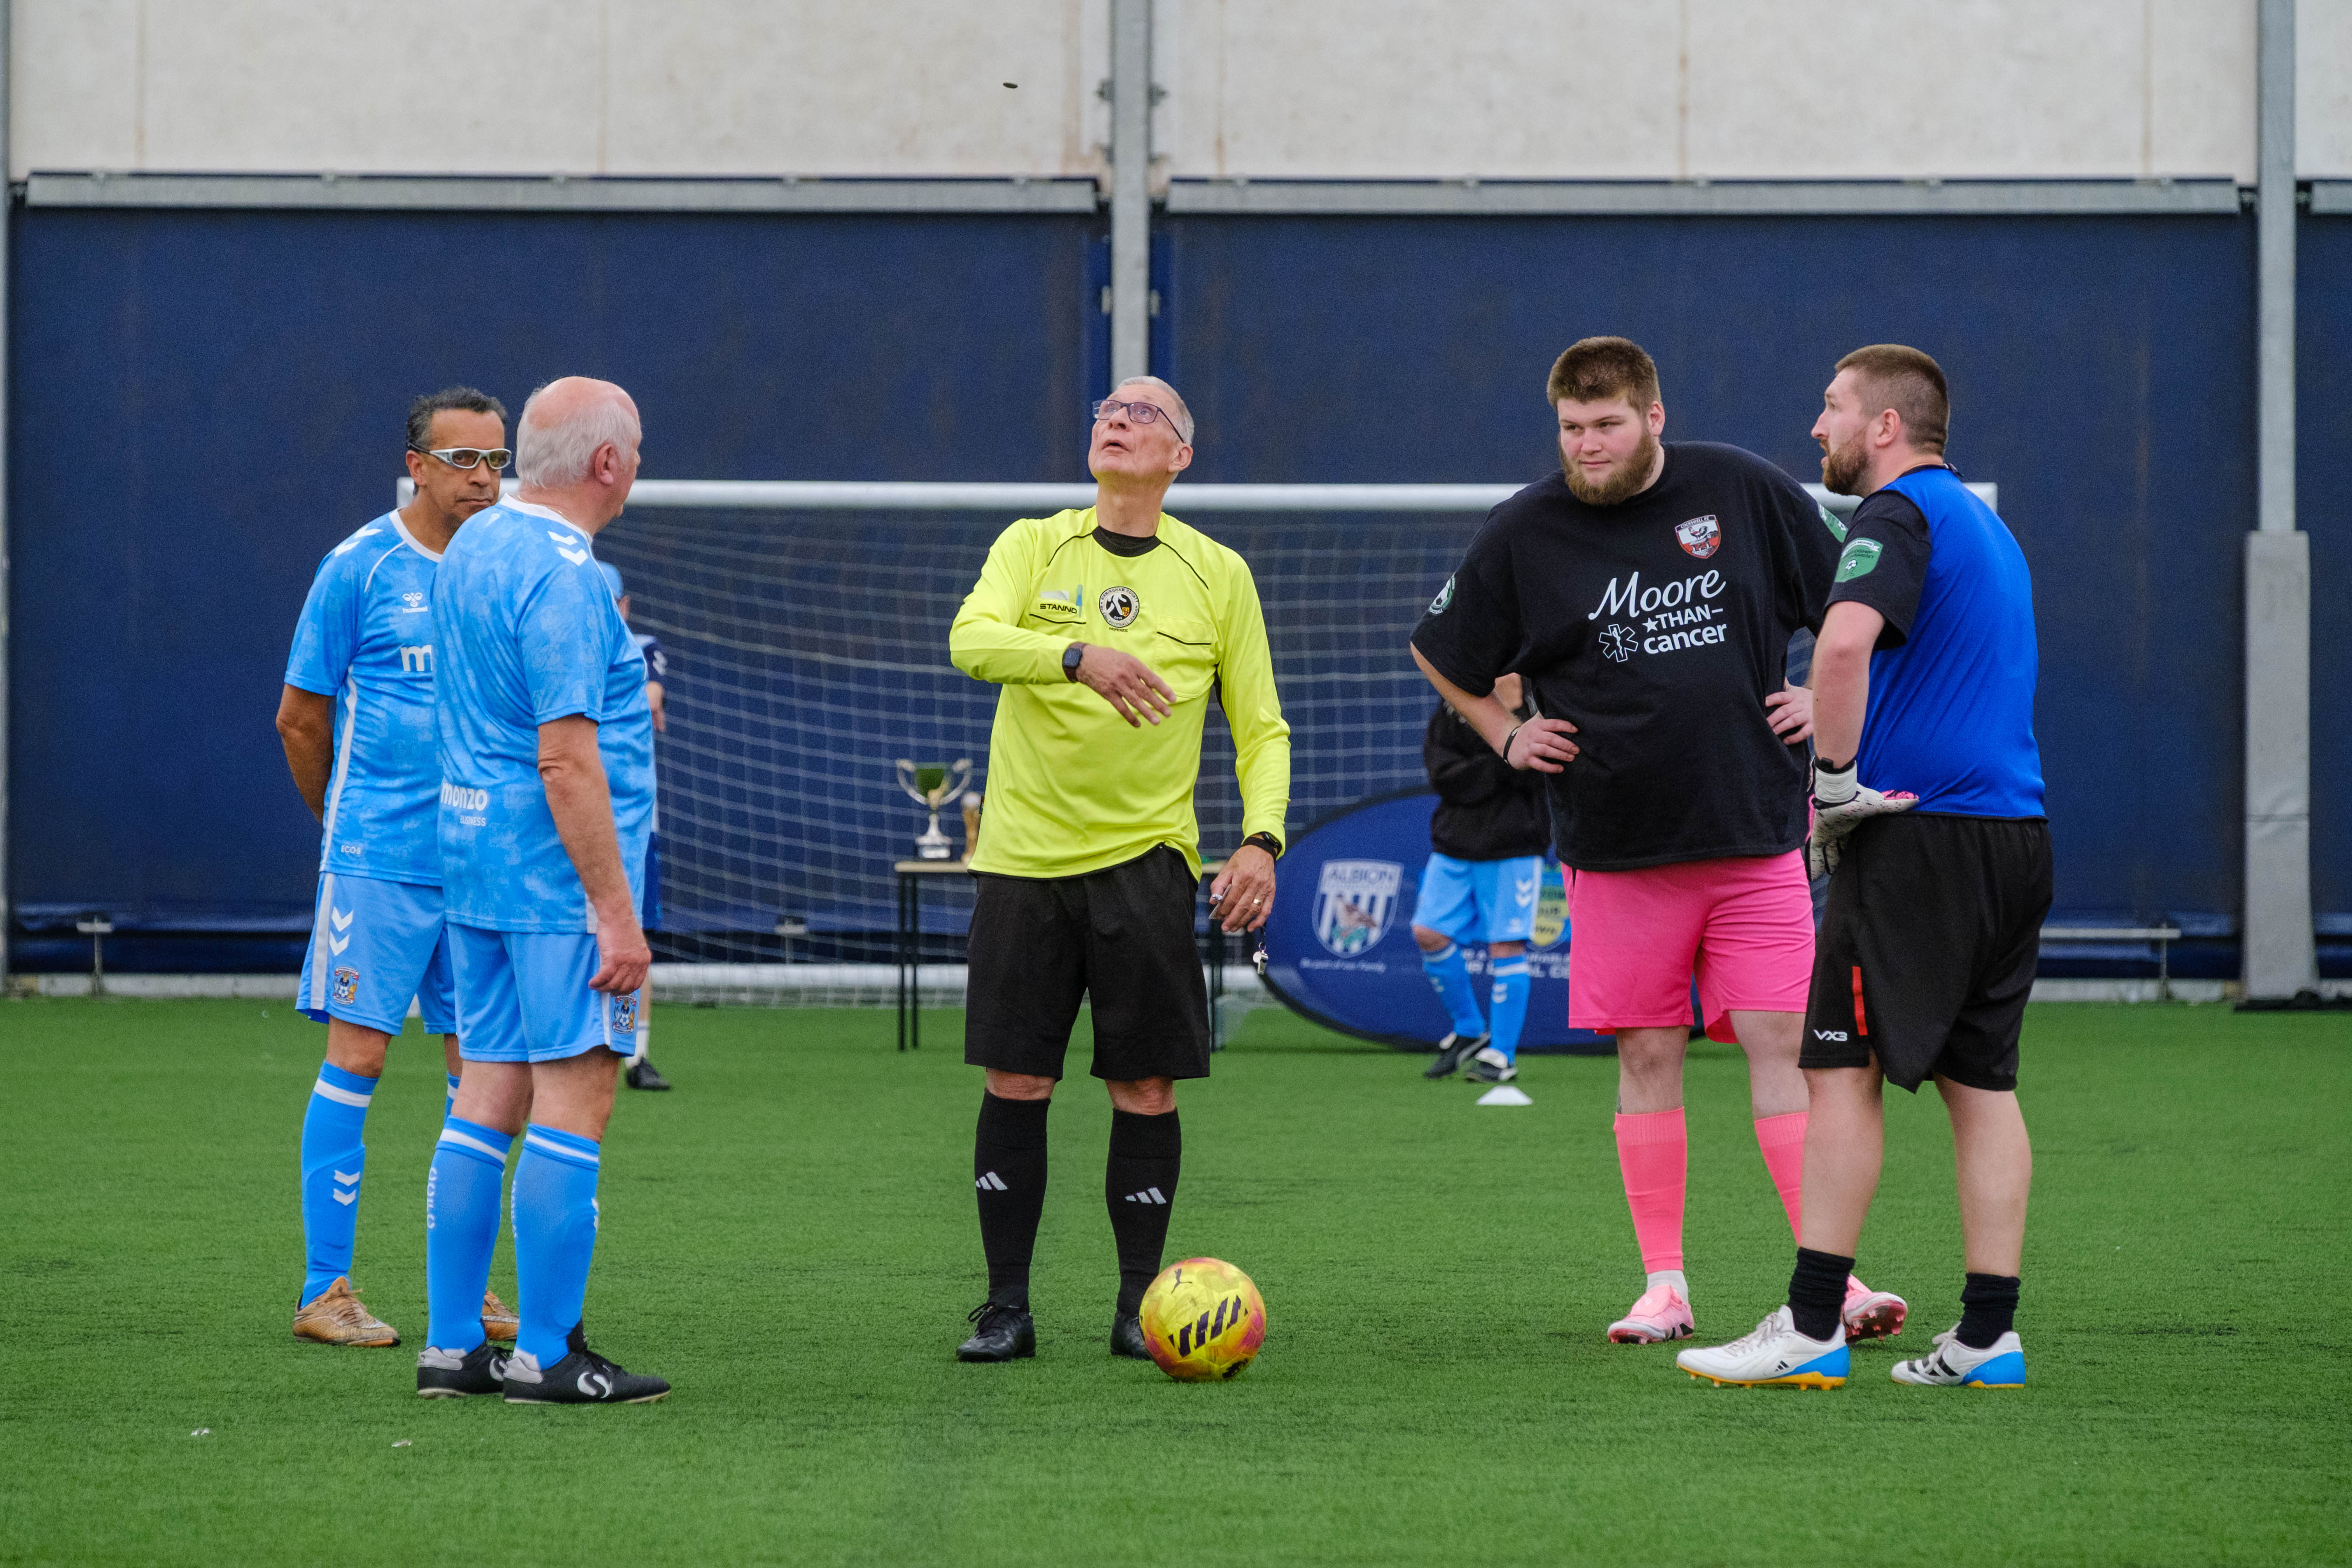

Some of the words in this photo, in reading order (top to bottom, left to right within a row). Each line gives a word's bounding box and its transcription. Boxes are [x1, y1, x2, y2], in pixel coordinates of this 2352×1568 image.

[1680, 518, 1704, 528] COCKSWELL
[1101, 588, 1125, 600] BIRMINGHAM
[1126, 589, 1138, 603] COUNTY
[1588, 570, 1726, 620] Moore
[1040, 604, 1077, 614] STANNO
[1643, 624, 1727, 654] cancer
[440, 782, 488, 811] monzo
[459, 814, 486, 827] BUSINESS
[1814, 1029, 1848, 1041] VX3
